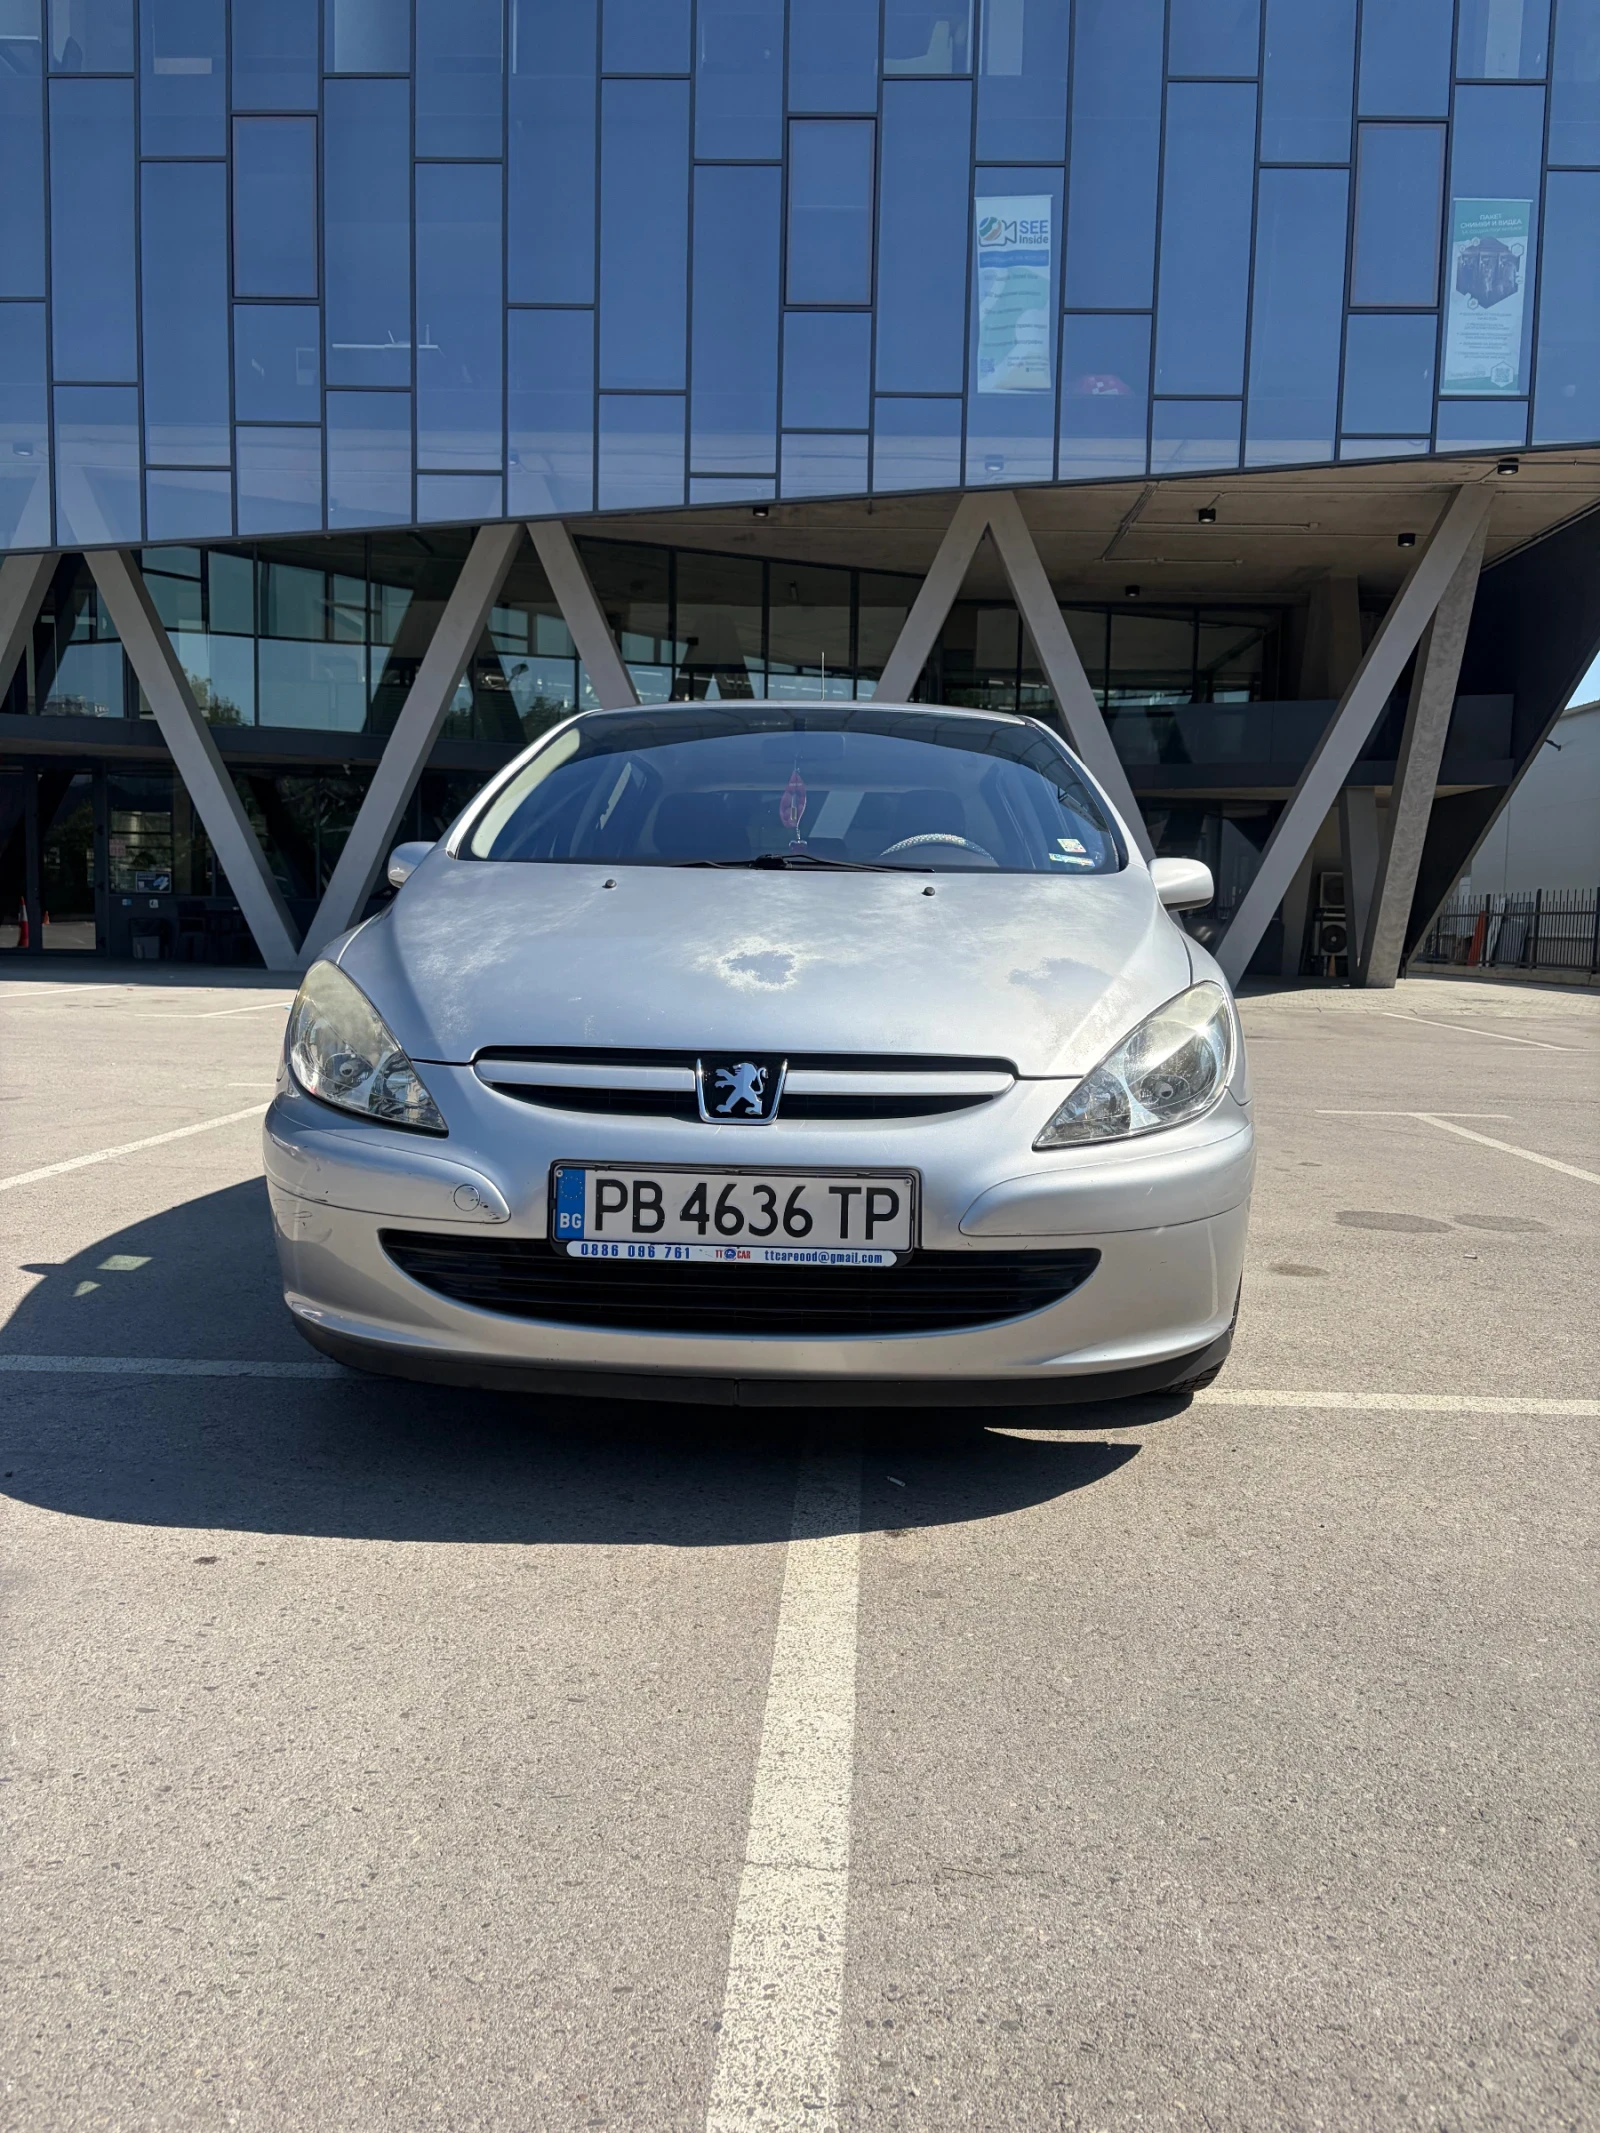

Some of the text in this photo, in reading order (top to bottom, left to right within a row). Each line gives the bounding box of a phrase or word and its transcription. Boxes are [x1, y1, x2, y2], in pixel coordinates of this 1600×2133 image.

[1019, 220, 1049, 234] SEE
[1498, 218, 1522, 226] ВИДЕА
[1019, 234, 1049, 245] Inside
[594, 1178, 899, 1240] PB 4636 TP
[559, 1212, 582, 1229] BG
[581, 1243, 619, 1257] 0886
[664, 1246, 690, 1259] 761
[715, 1249, 723, 1258] TT
[737, 1250, 751, 1259] CAR
[764, 1250, 883, 1264] ttcareood@gmail.com
